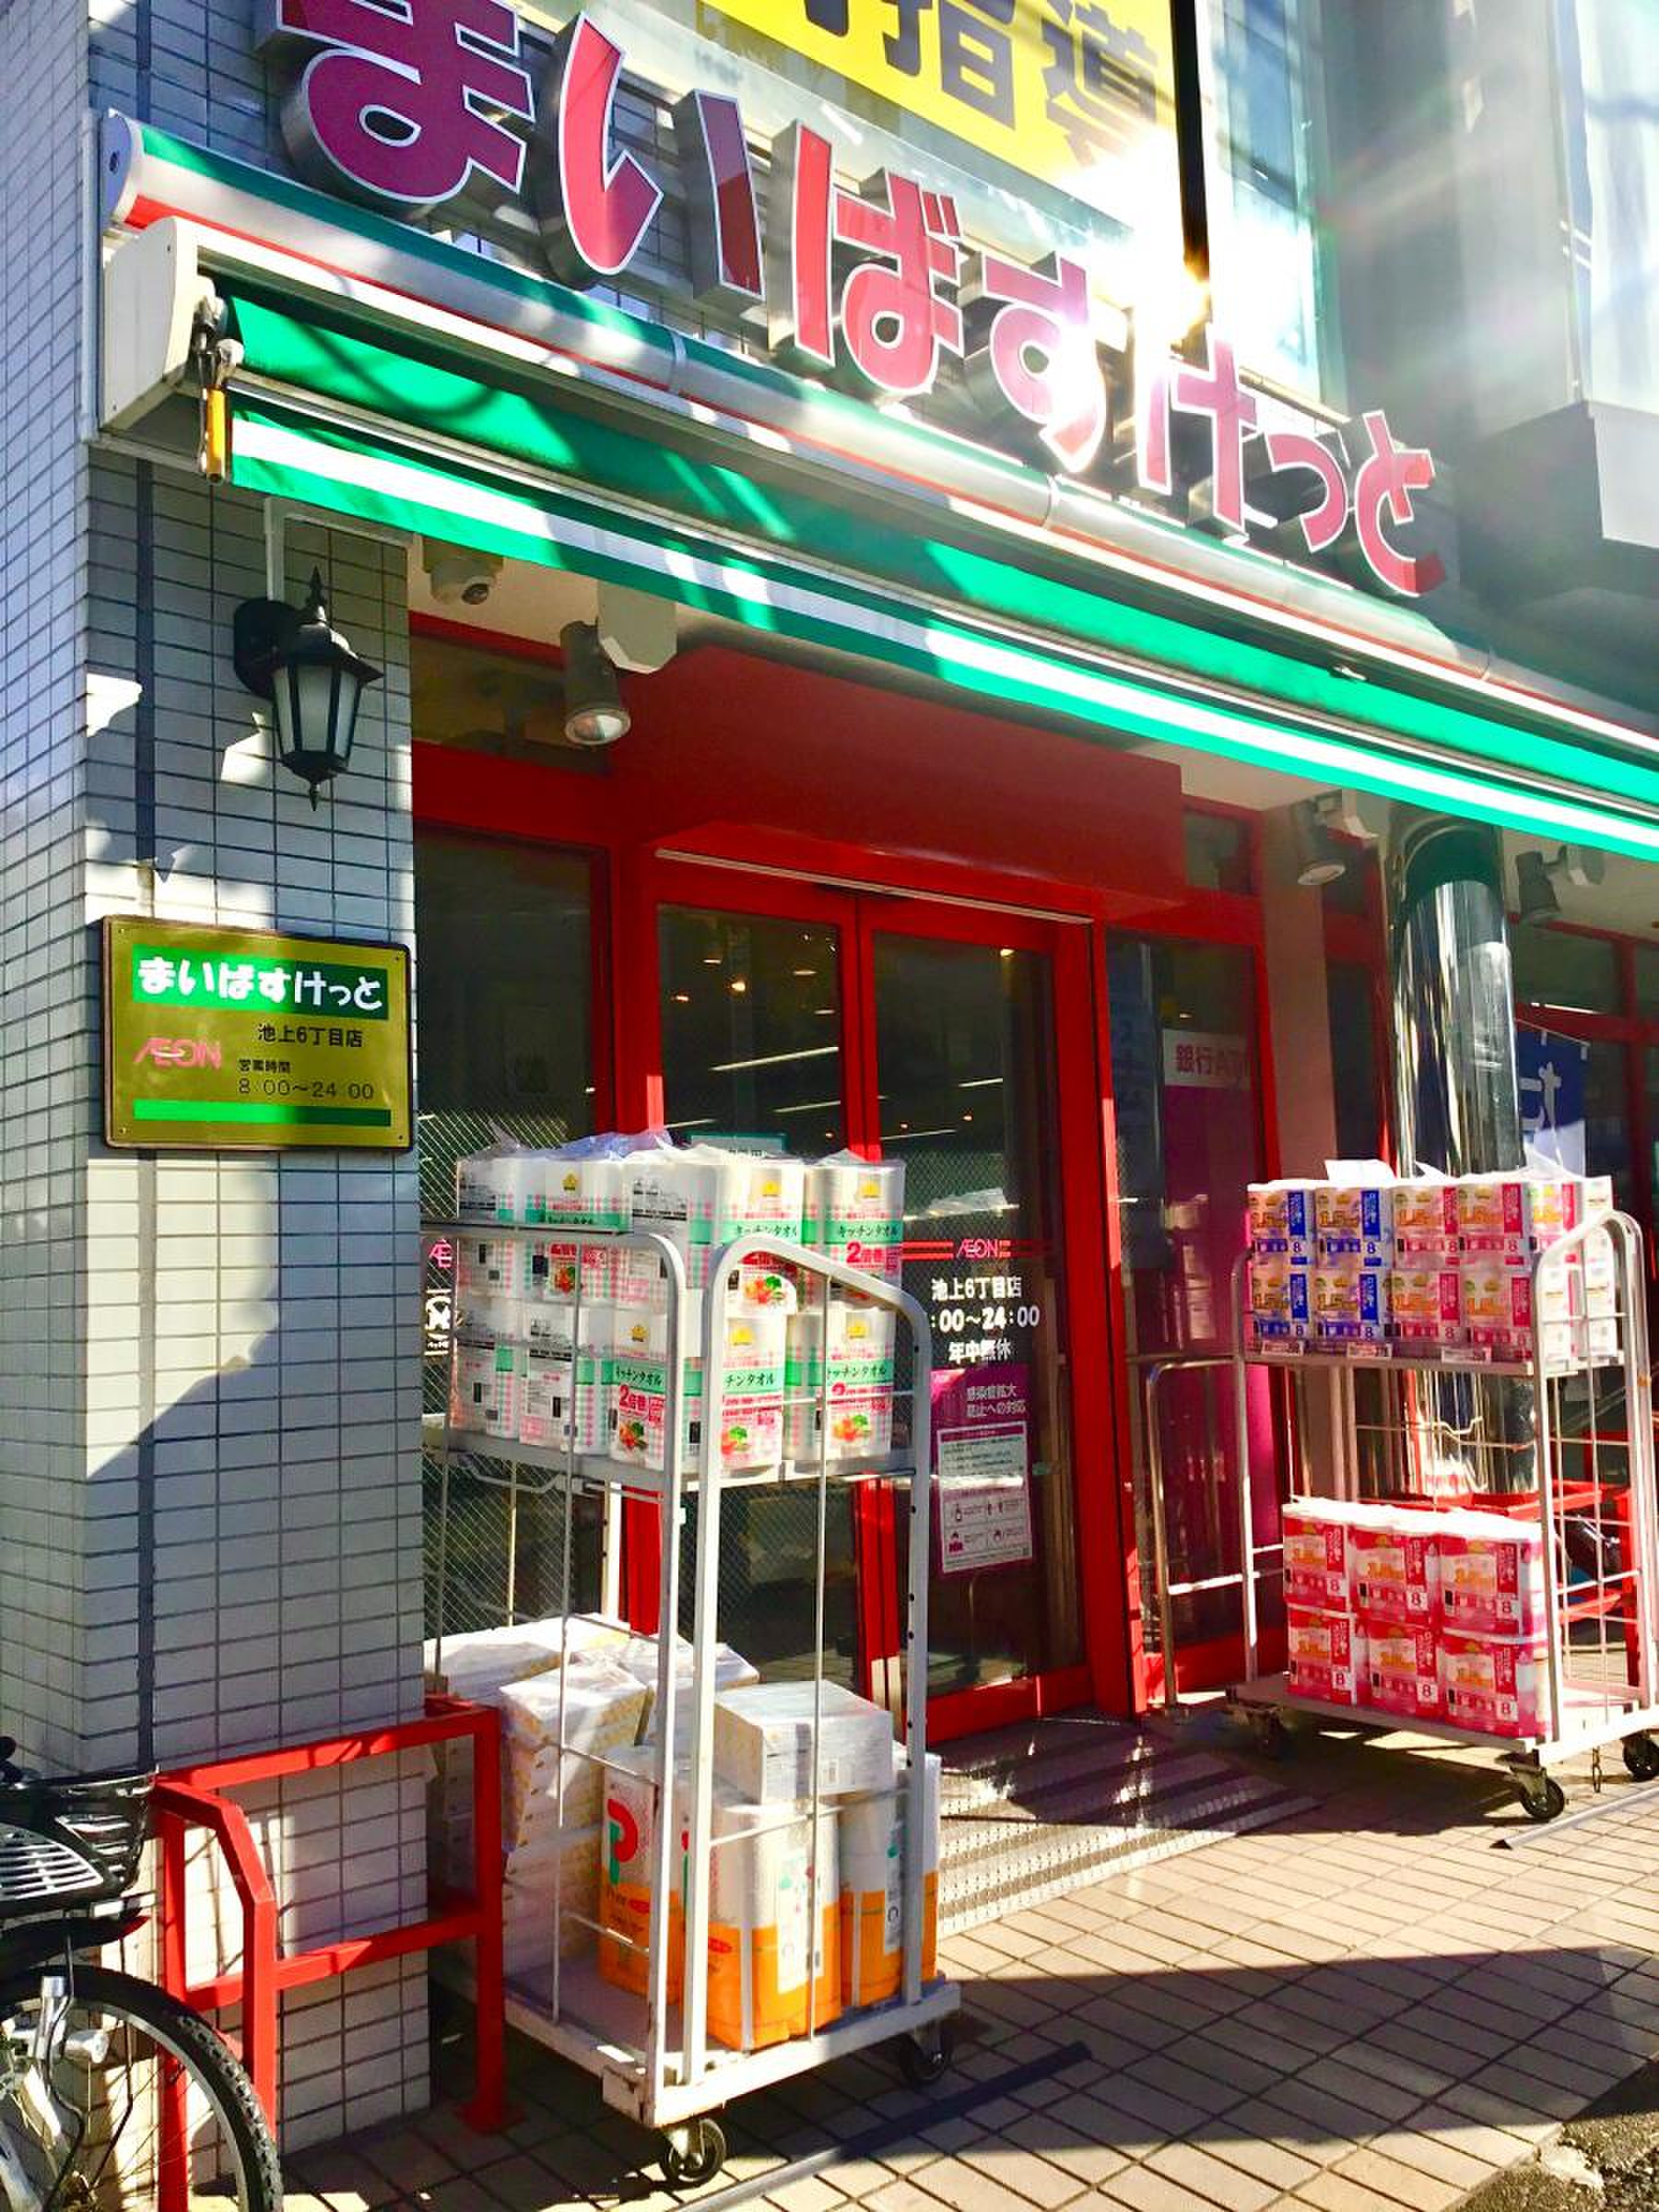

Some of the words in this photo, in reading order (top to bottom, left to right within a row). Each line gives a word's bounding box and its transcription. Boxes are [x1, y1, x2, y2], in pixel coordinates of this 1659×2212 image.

[276, 0, 1444, 597] まいばすけっと
[138, 957, 382, 1010] まいばすけっと
[258, 1024, 363, 1048] 池上6丁目店
[931, 1276, 1022, 1301] 池上6丁目店
[948, 1337, 1011, 1363] 年中無休
